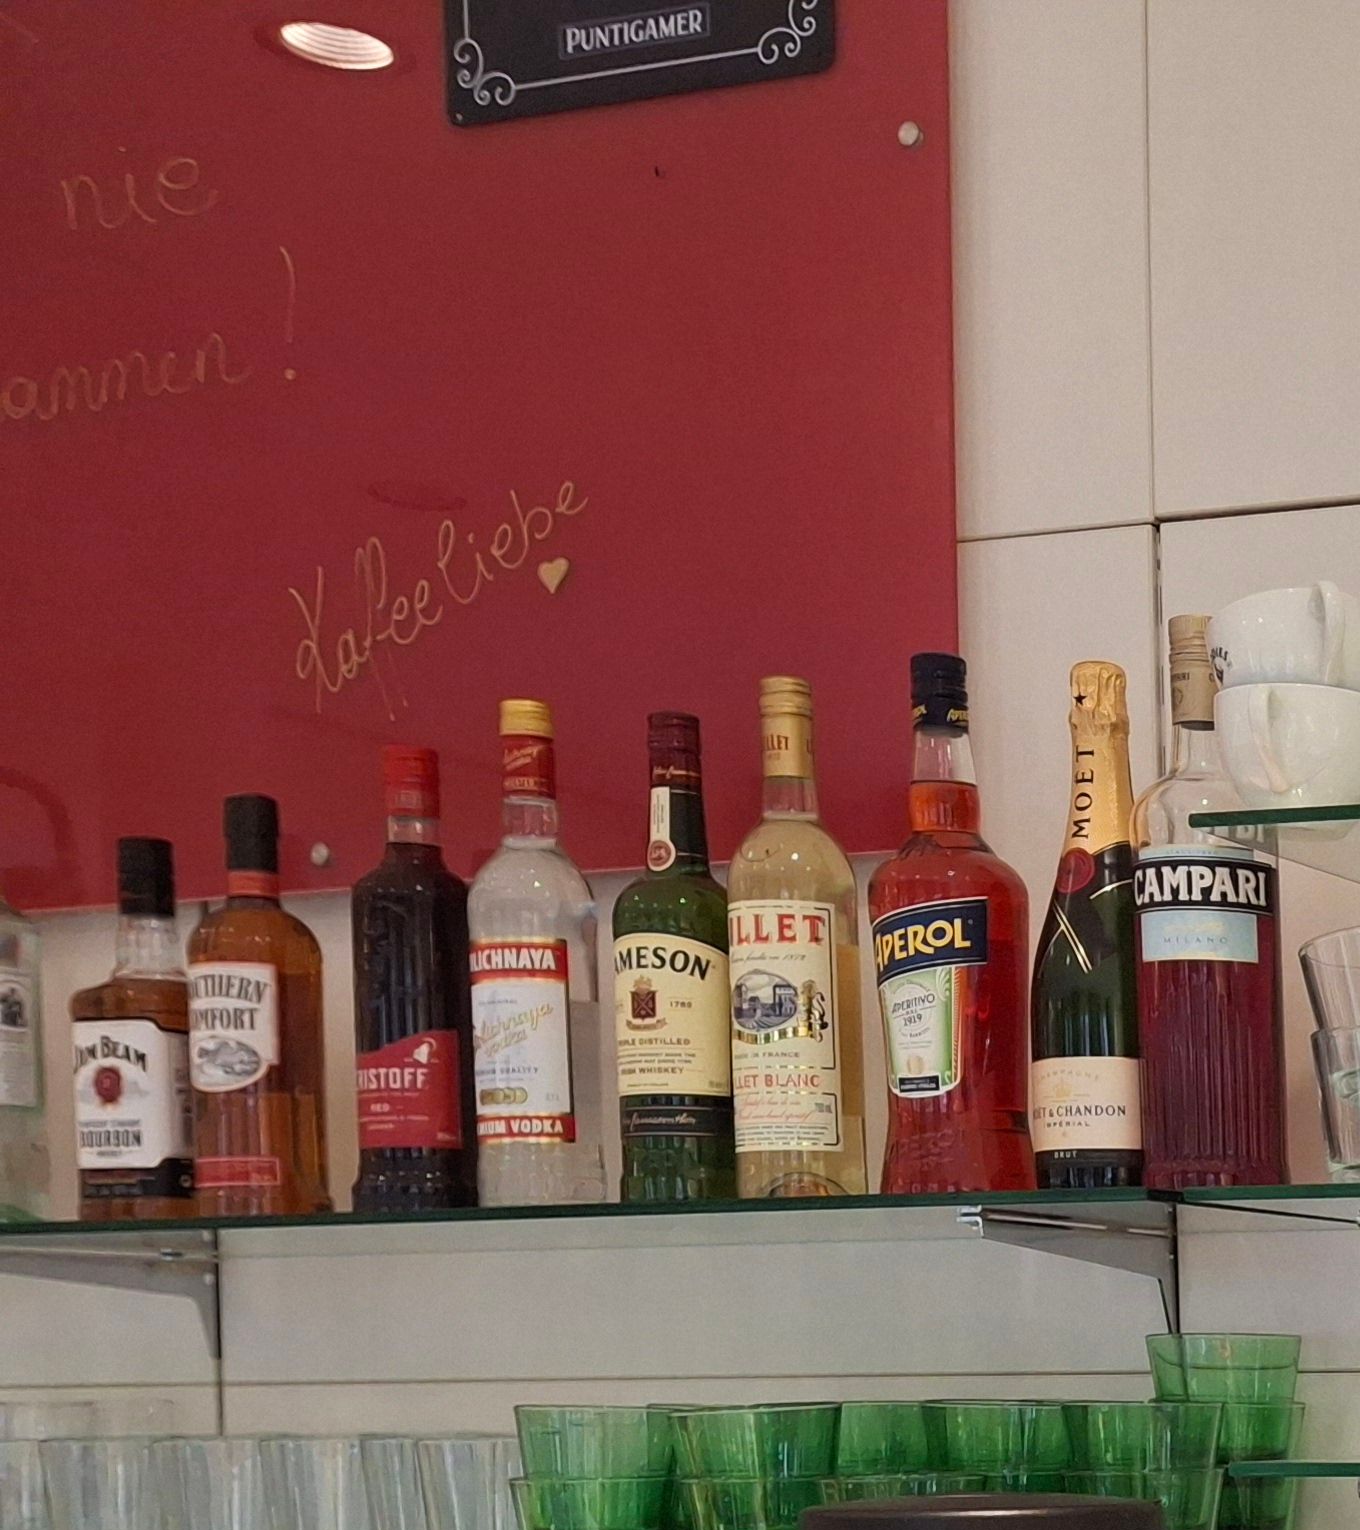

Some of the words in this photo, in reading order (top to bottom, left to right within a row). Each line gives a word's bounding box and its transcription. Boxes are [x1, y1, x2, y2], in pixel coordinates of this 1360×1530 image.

[565, 9, 703, 54] PUNTIGAMER
[61, 147, 219, 230] nie
[1134, 865, 1267, 907] CAMPARI
[875, 917, 972, 972] APEROL
[1163, 935, 1229, 945] MILANO
[892, 992, 936, 1015] APERITIVO
[639, 1037, 691, 1046] DISTILLED
[100, 1035, 147, 1073] BEAM
[638, 1067, 685, 1075] WHISKEY
[764, 1073, 821, 1088] BLANC
[1056, 1104, 1127, 1117] CHANDON
[510, 1118, 564, 1134] VODKA
[1054, 1150, 1078, 1159] BRUT
